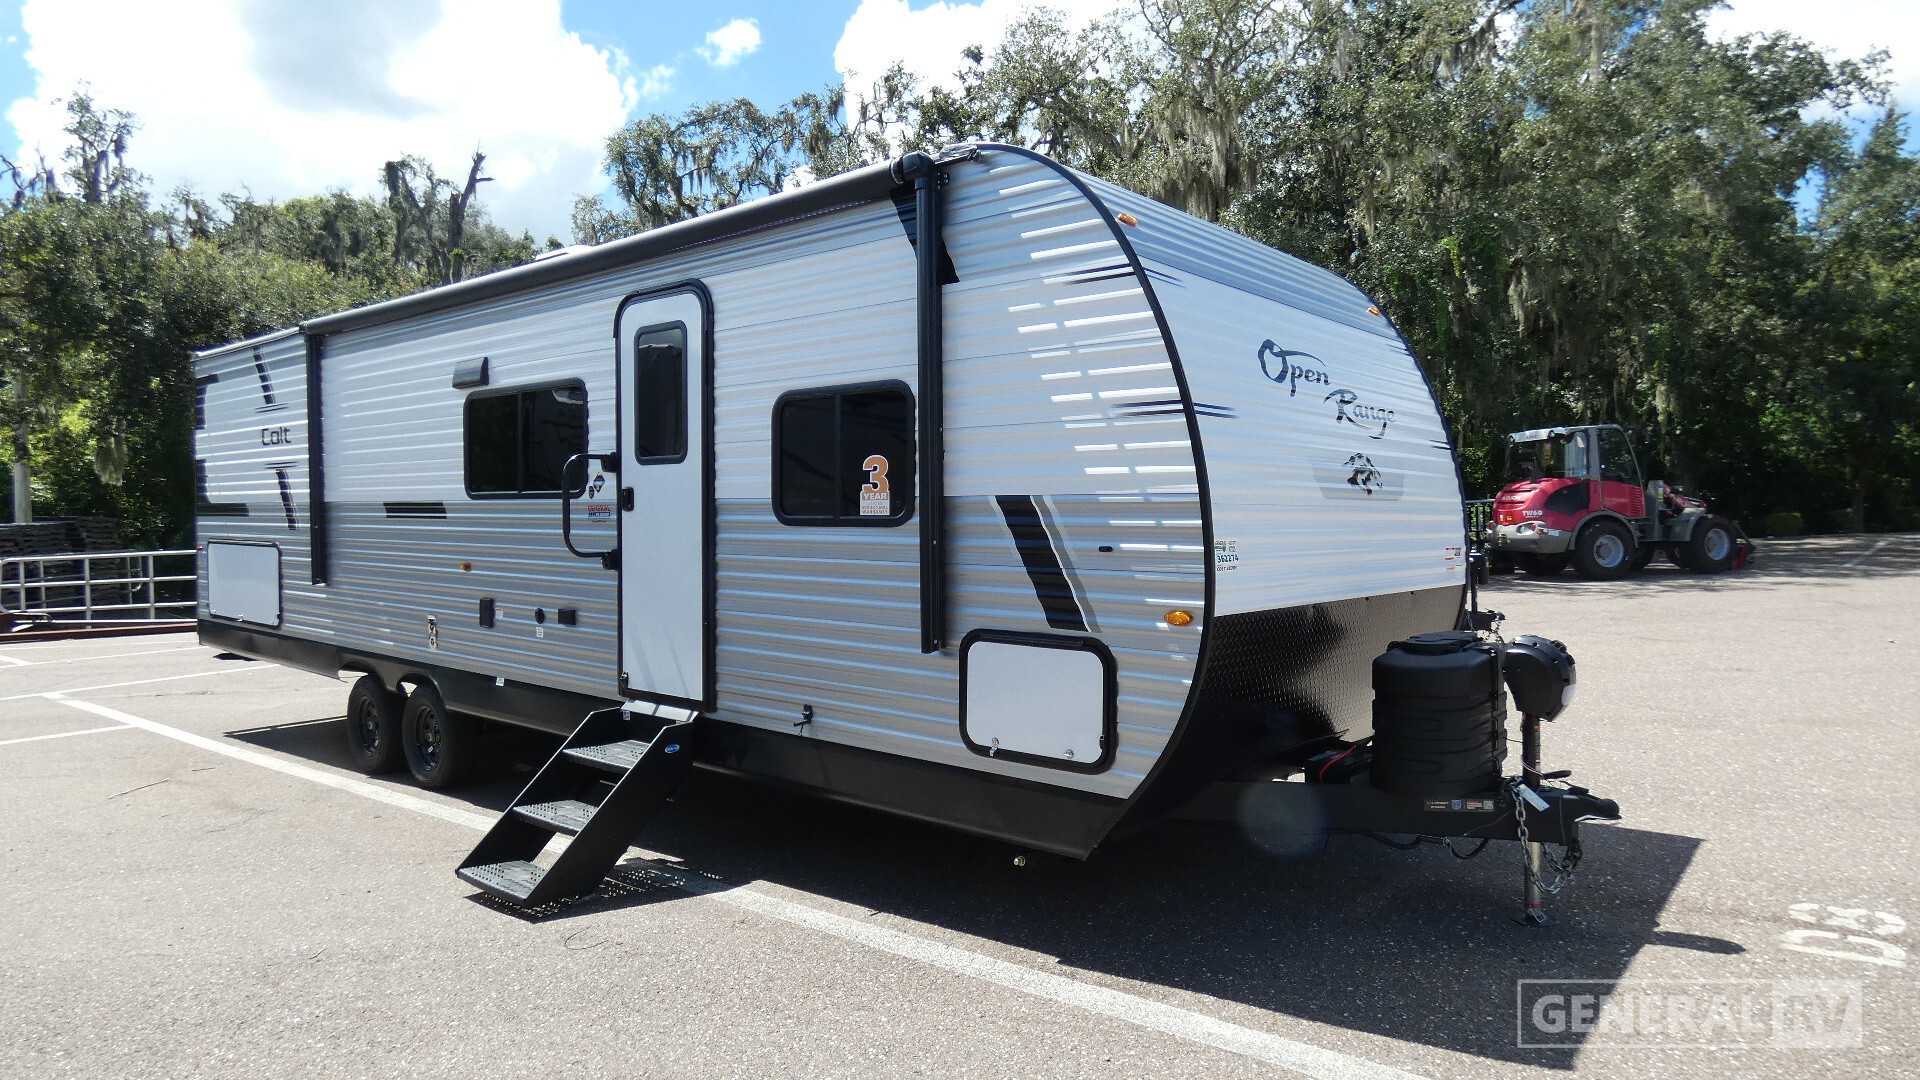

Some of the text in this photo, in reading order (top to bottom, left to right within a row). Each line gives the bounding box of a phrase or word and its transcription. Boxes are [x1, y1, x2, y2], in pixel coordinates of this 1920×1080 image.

[1257, 338, 1332, 397] Open
[1323, 388, 1397, 440] Range
[261, 426, 292, 446] Colt
[862, 454, 890, 493] 3
[863, 492, 887, 500] YEAR
